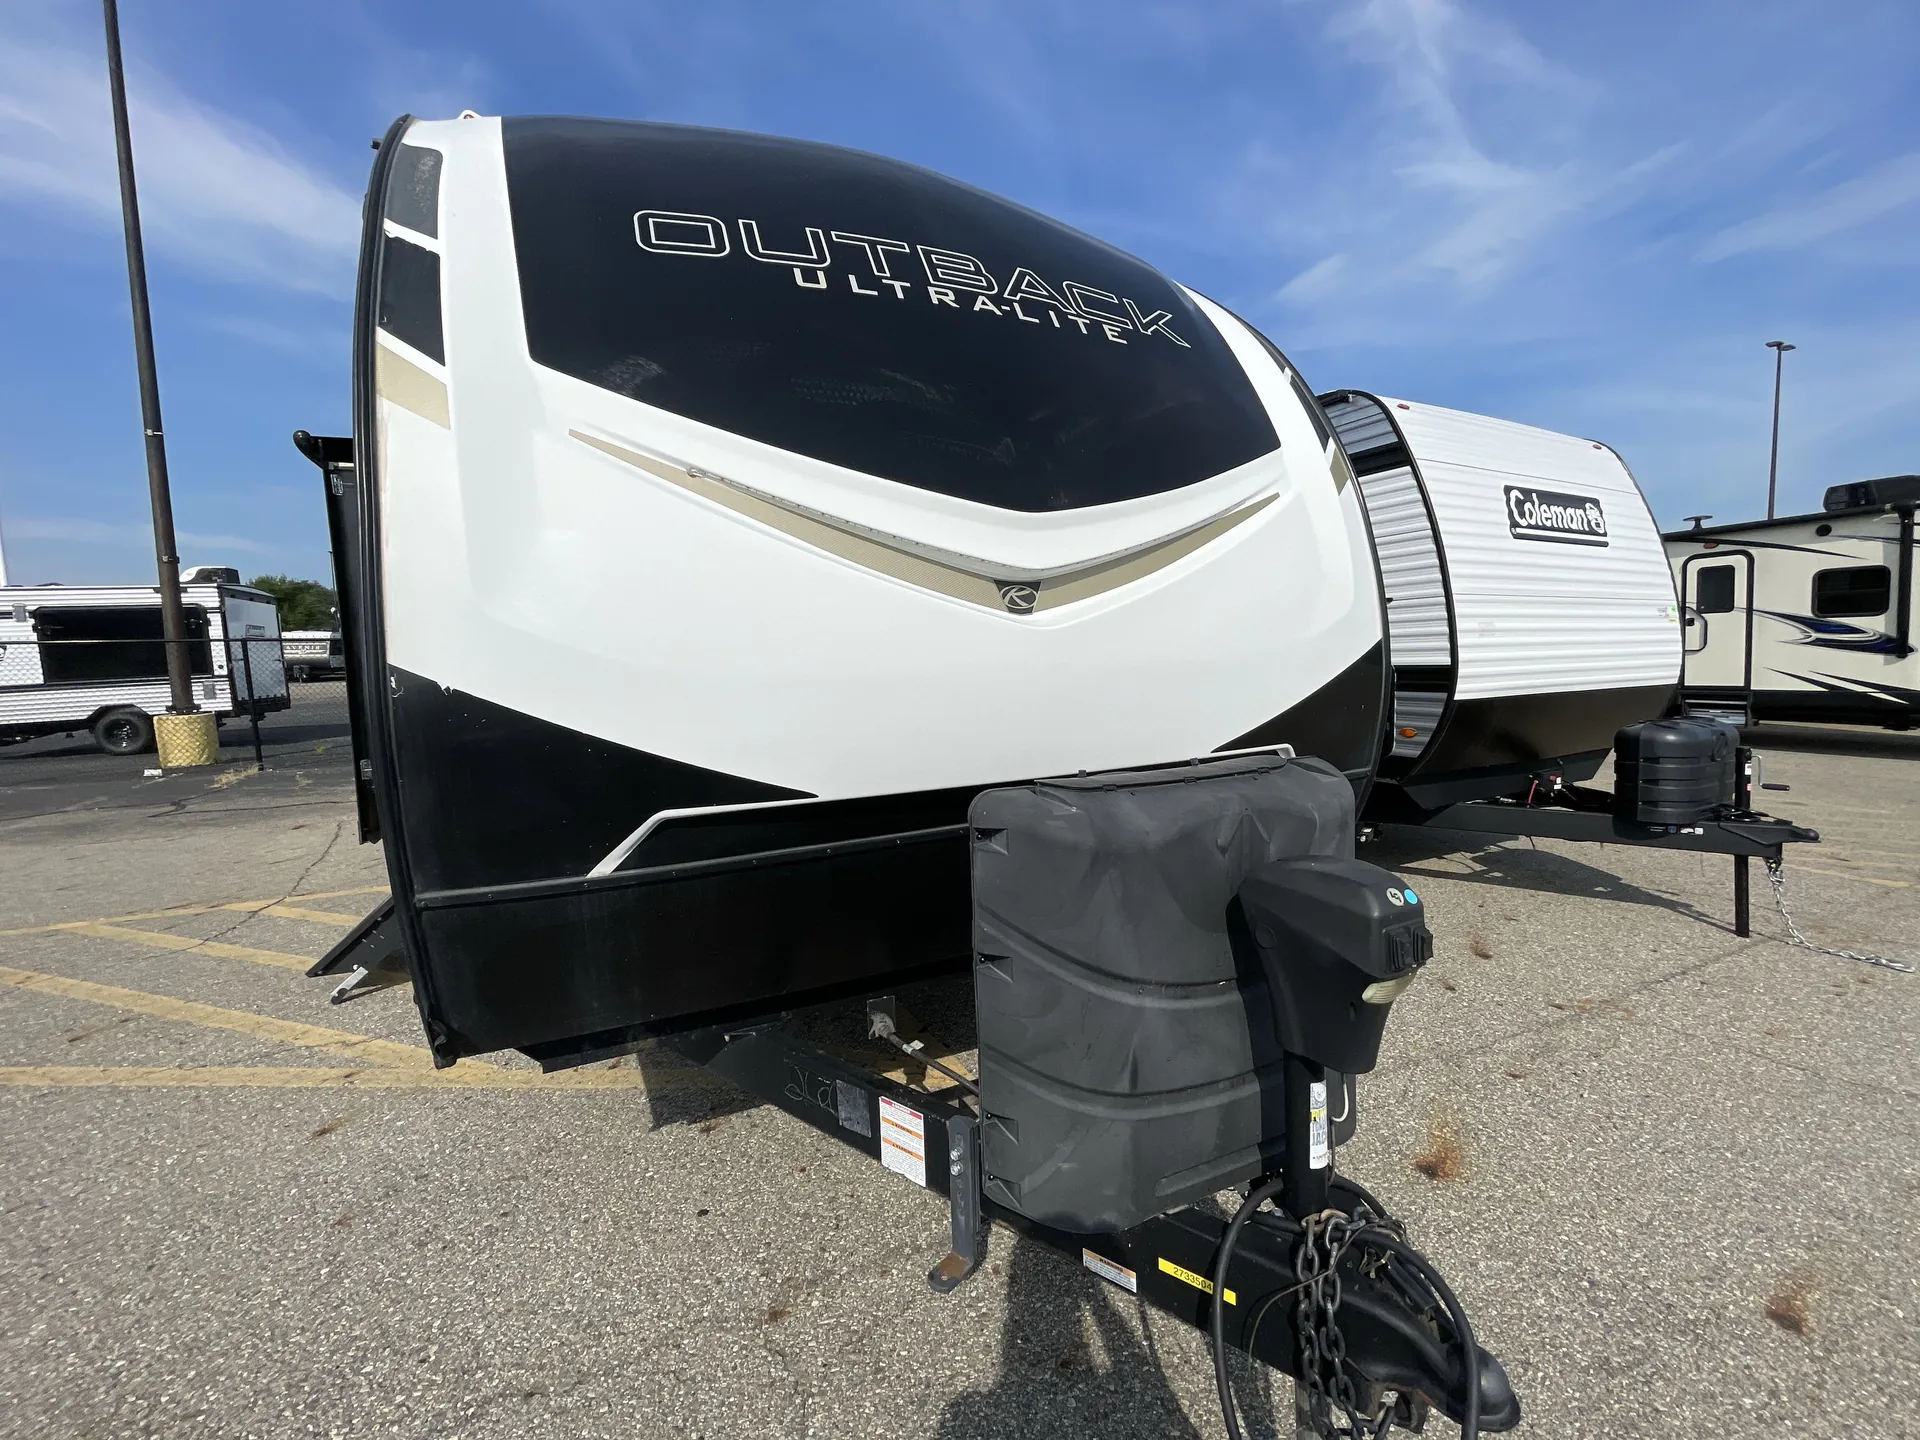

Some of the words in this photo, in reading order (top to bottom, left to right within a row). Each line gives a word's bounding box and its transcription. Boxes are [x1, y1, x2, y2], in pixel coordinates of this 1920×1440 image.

[633, 209, 1192, 348] OUTBACK
[793, 267, 1128, 345] ULTRA-LITE
[1509, 488, 1590, 532] Coleman
[1173, 1266, 1212, 1291] 2733504
